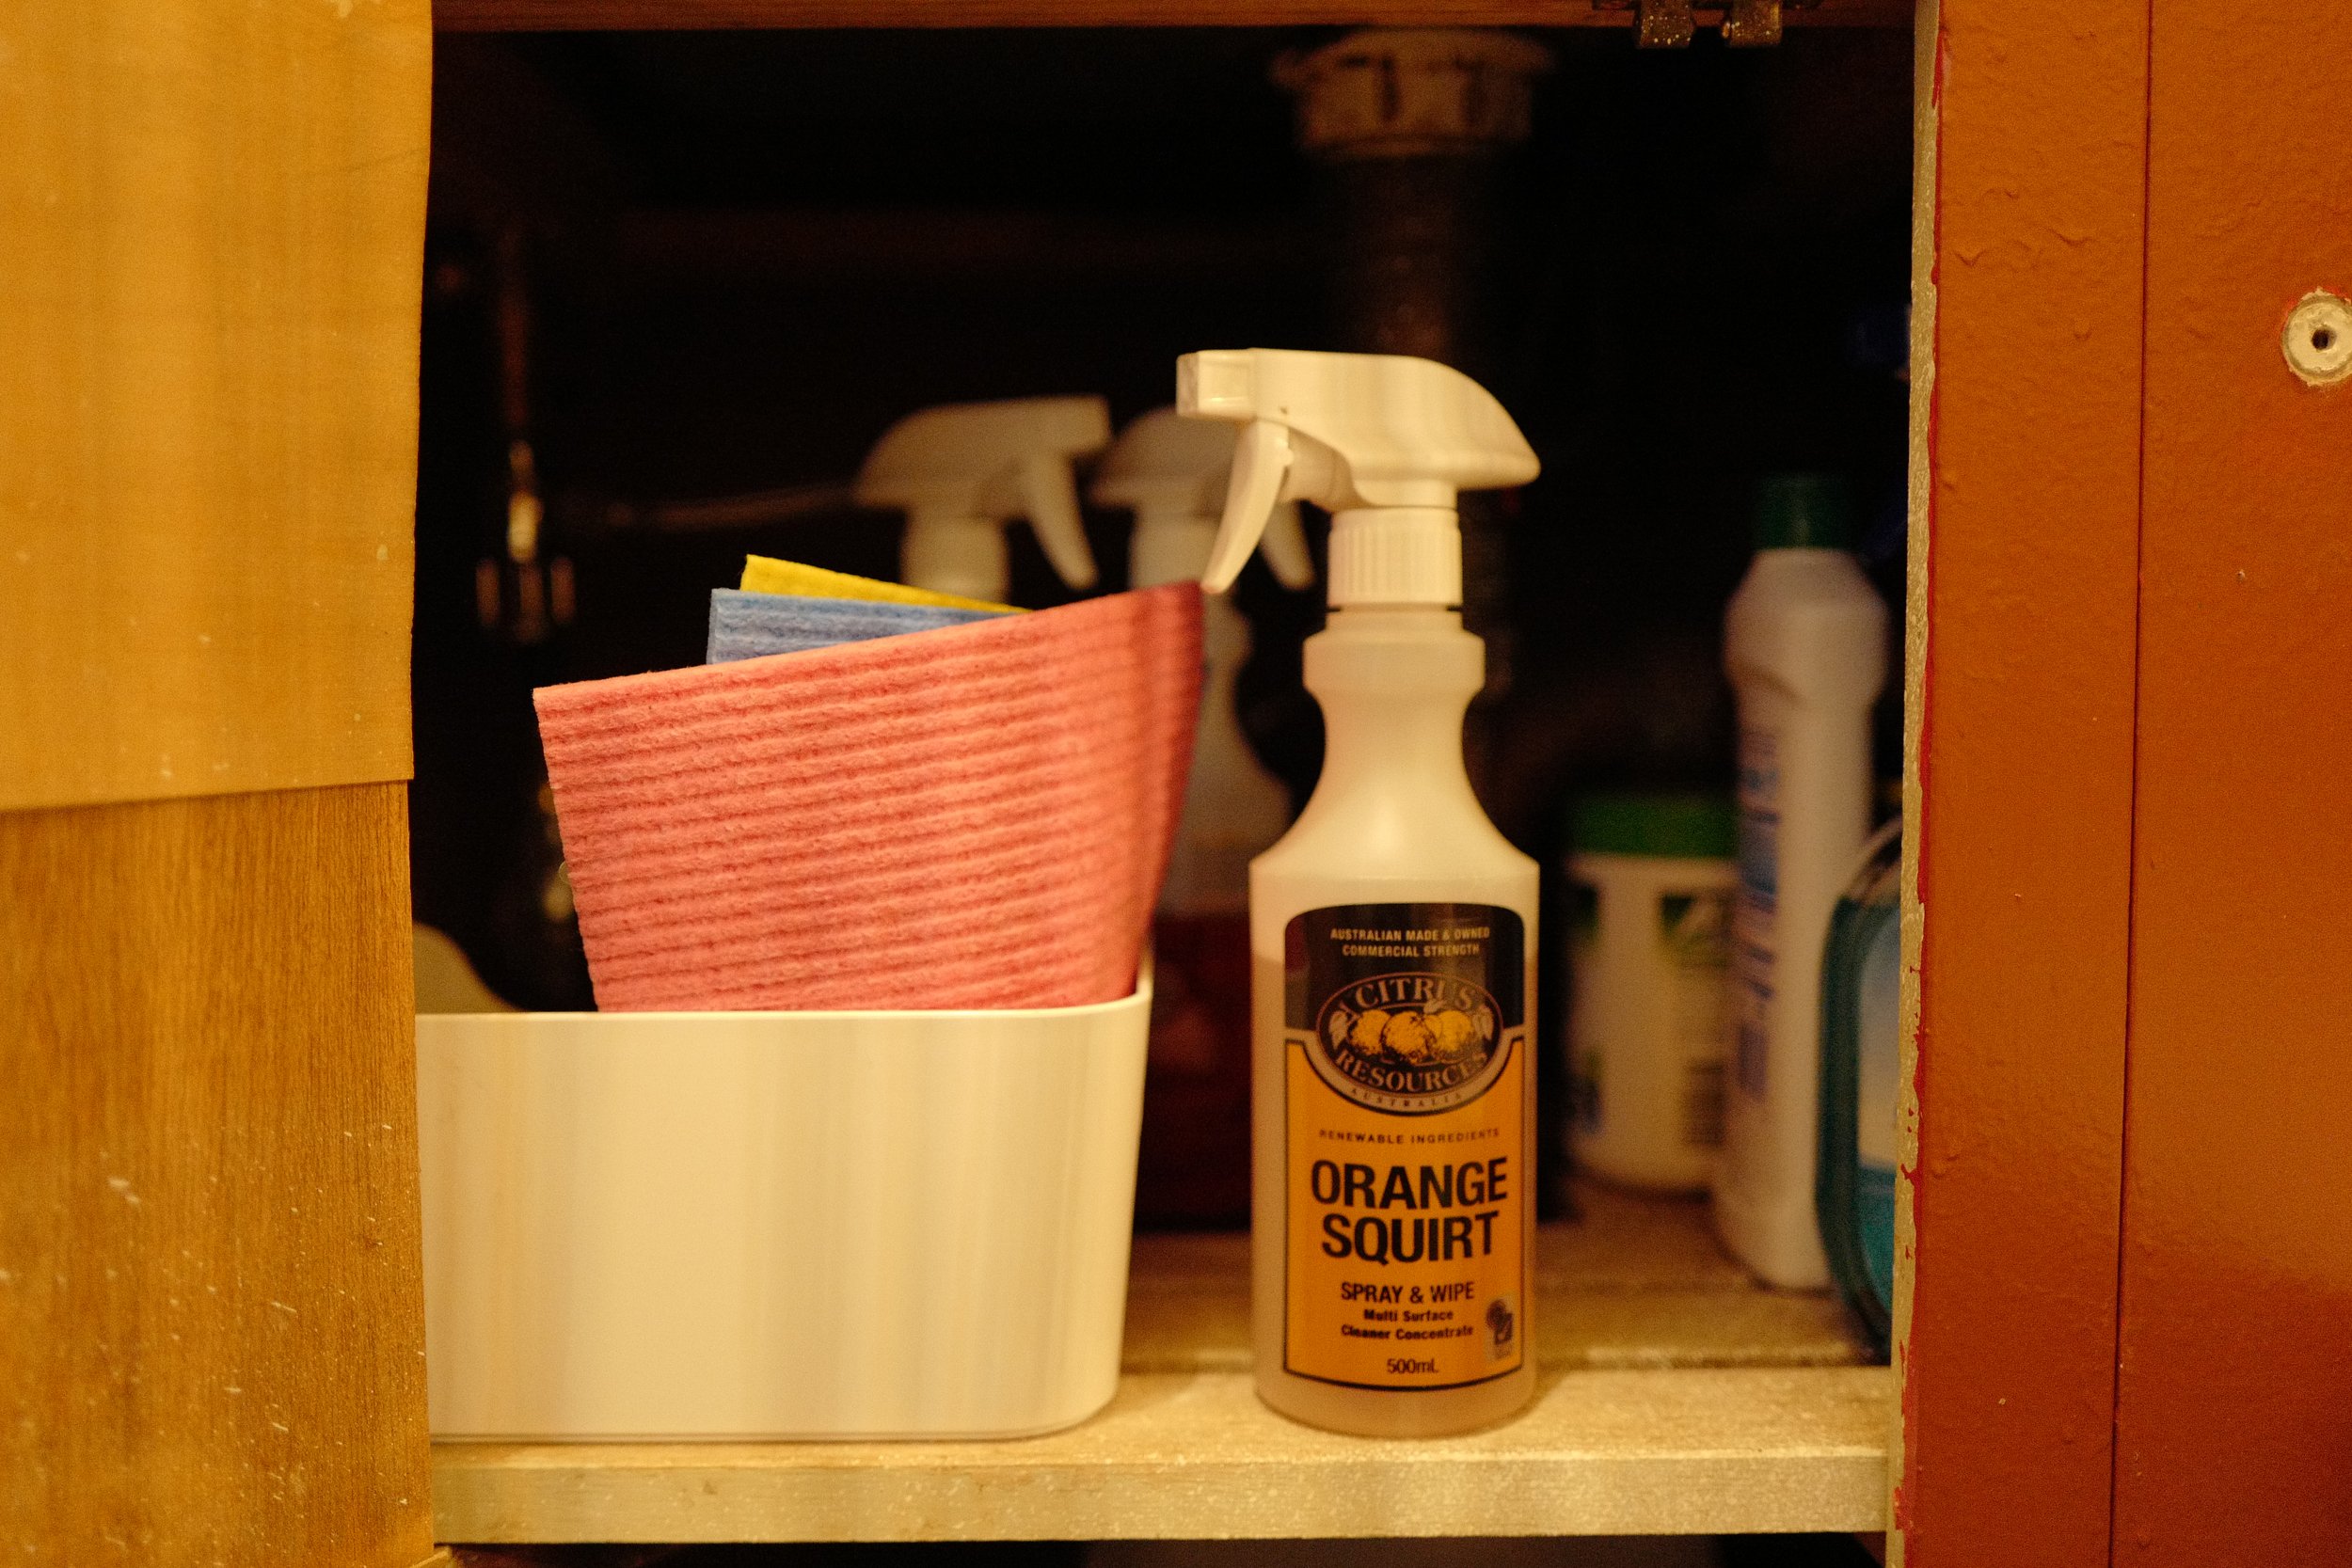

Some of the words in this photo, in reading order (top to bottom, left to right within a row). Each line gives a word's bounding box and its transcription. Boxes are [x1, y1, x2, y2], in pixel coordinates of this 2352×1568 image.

[1330, 928, 1402, 941] AUSTRALIAN
[1406, 928, 1438, 941] MADE
[1454, 927, 1490, 940] OWNED
[1343, 944, 1419, 958] COMMERCIAL
[1423, 943, 1480, 957] STRENGTH
[1319, 1130, 1404, 1145] RENEWABLE
[1411, 1128, 1500, 1144] INGREDIENTS
[1311, 1156, 1507, 1210] ORANGE
[1322, 1211, 1499, 1266] SQUIRT
[1341, 1282, 1404, 1304] SPRAY
[1409, 1286, 1423, 1304] &
[1430, 1282, 1474, 1302] WIPE
[1364, 1308, 1398, 1322] Multi
[1404, 1308, 1454, 1322] Surface
[1342, 1324, 1391, 1339] Cleaner
[1396, 1324, 1474, 1339] Concentrate
